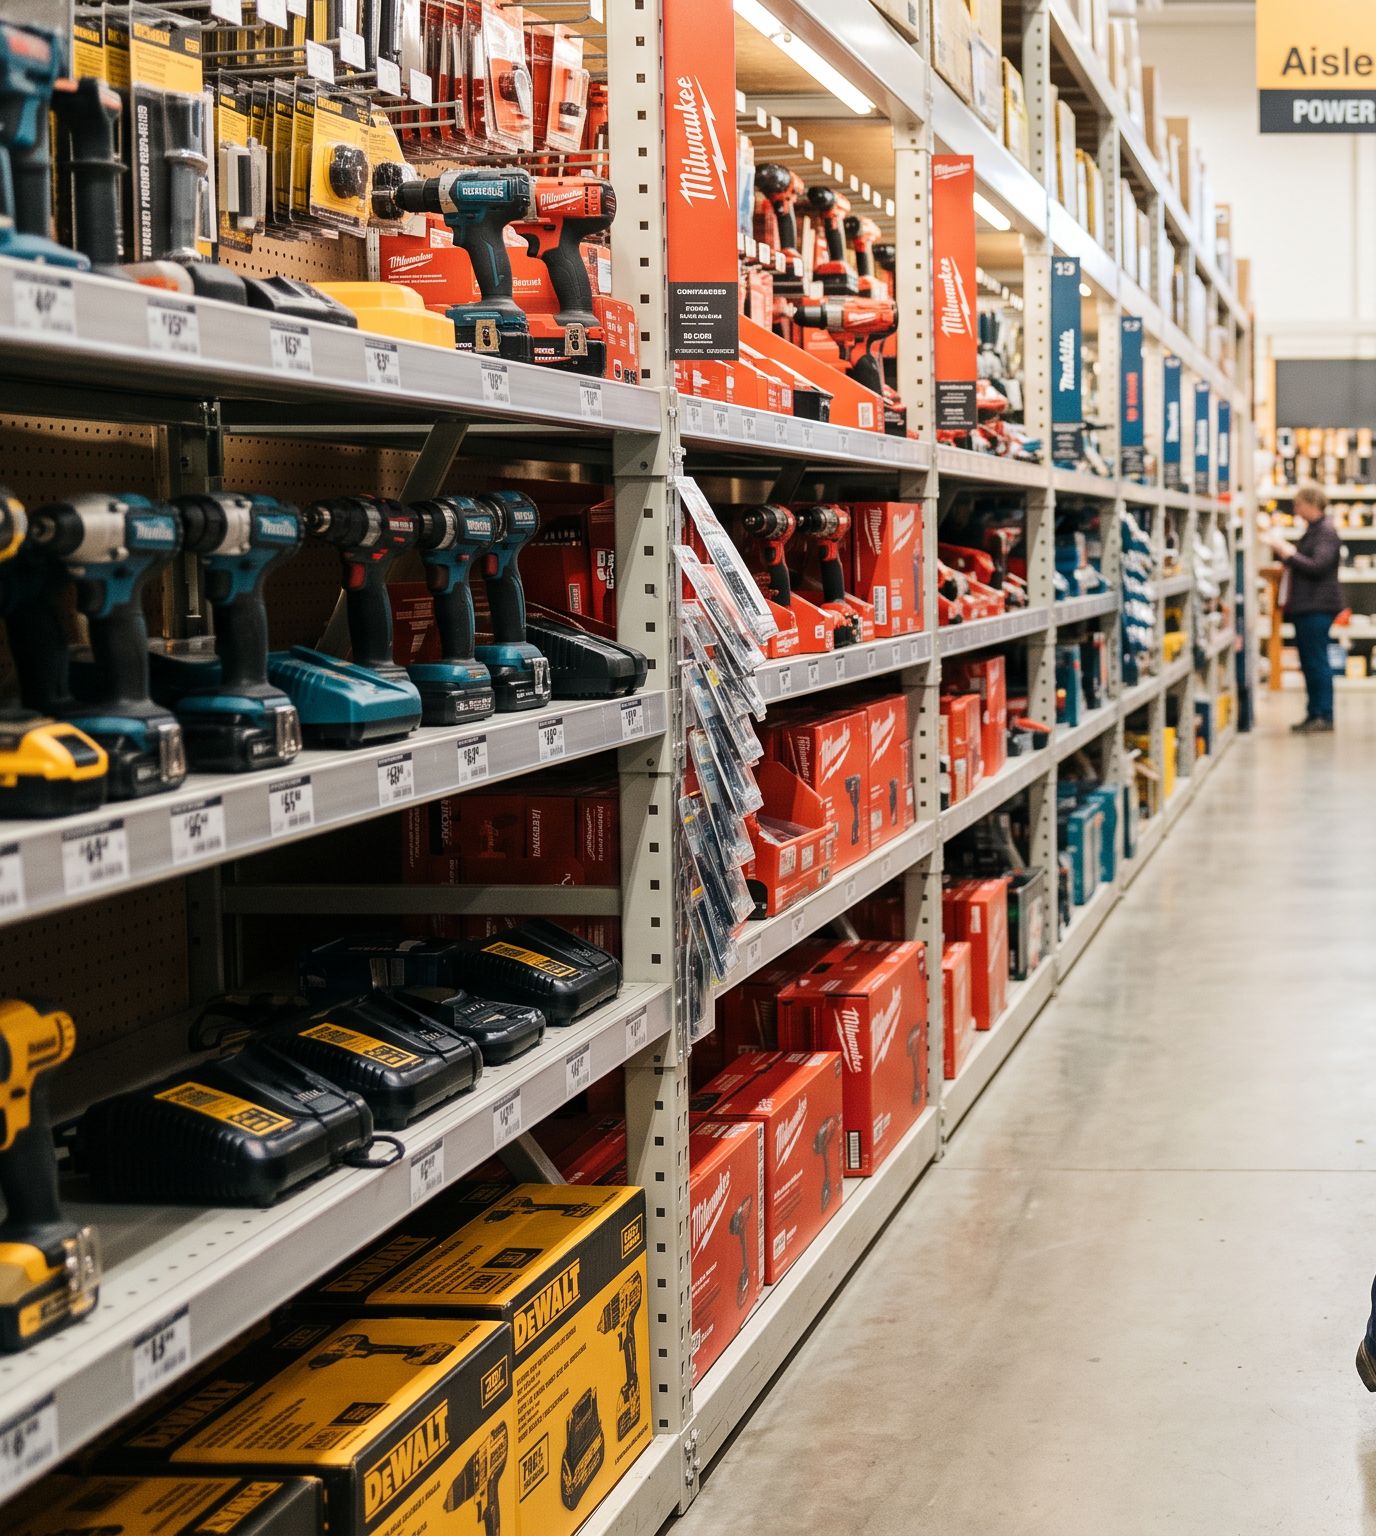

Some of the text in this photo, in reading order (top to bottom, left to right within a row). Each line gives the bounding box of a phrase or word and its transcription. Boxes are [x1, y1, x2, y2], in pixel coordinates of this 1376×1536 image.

[1281, 46, 1374, 76] Aisle
[673, 75, 717, 208] Milwaukee
[1292, 99, 1376, 125] POWER
[513, 1262, 580, 1345] DEWALT
[364, 1411, 450, 1516] DEWALT
